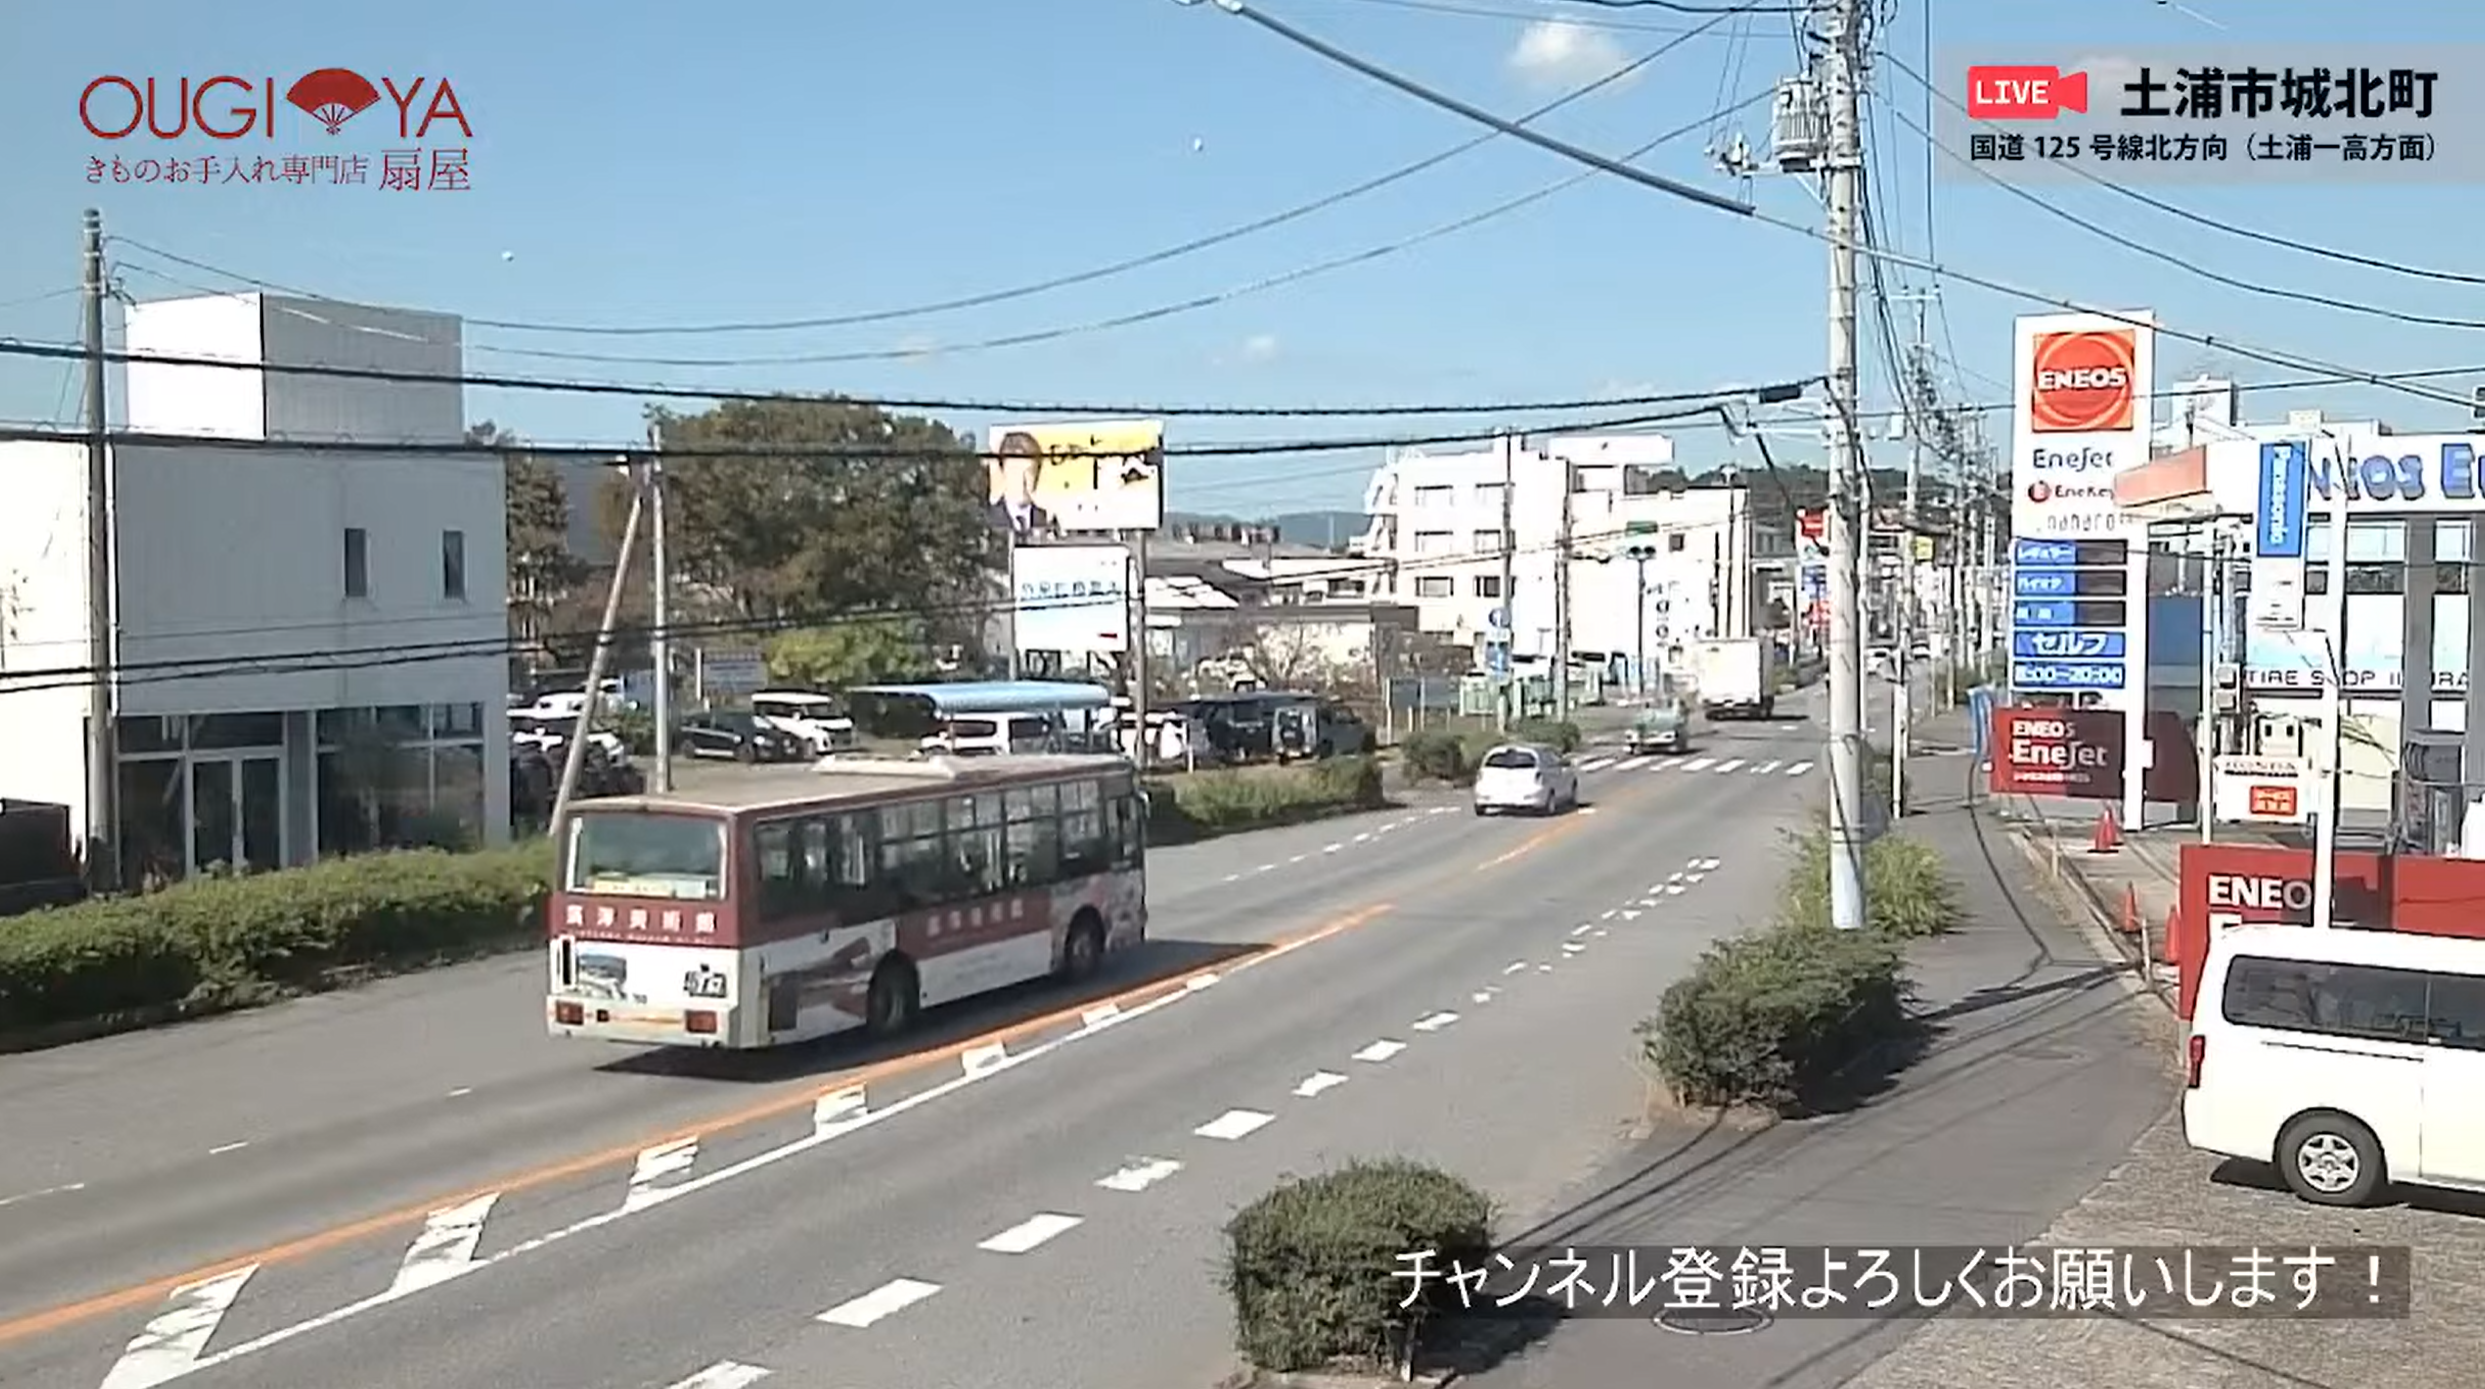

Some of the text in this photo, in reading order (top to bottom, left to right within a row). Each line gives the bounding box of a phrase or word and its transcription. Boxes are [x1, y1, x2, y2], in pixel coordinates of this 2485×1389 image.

[2037, 367, 2128, 392] ENEOS
[2031, 632, 2109, 657] セルフ
[2247, 669, 2299, 686] TIRE
[2310, 669, 2377, 687] SOP
[2011, 719, 2077, 738] ENEOS
[2011, 738, 2108, 770] EneJet
[2208, 874, 2313, 911] ENEO
